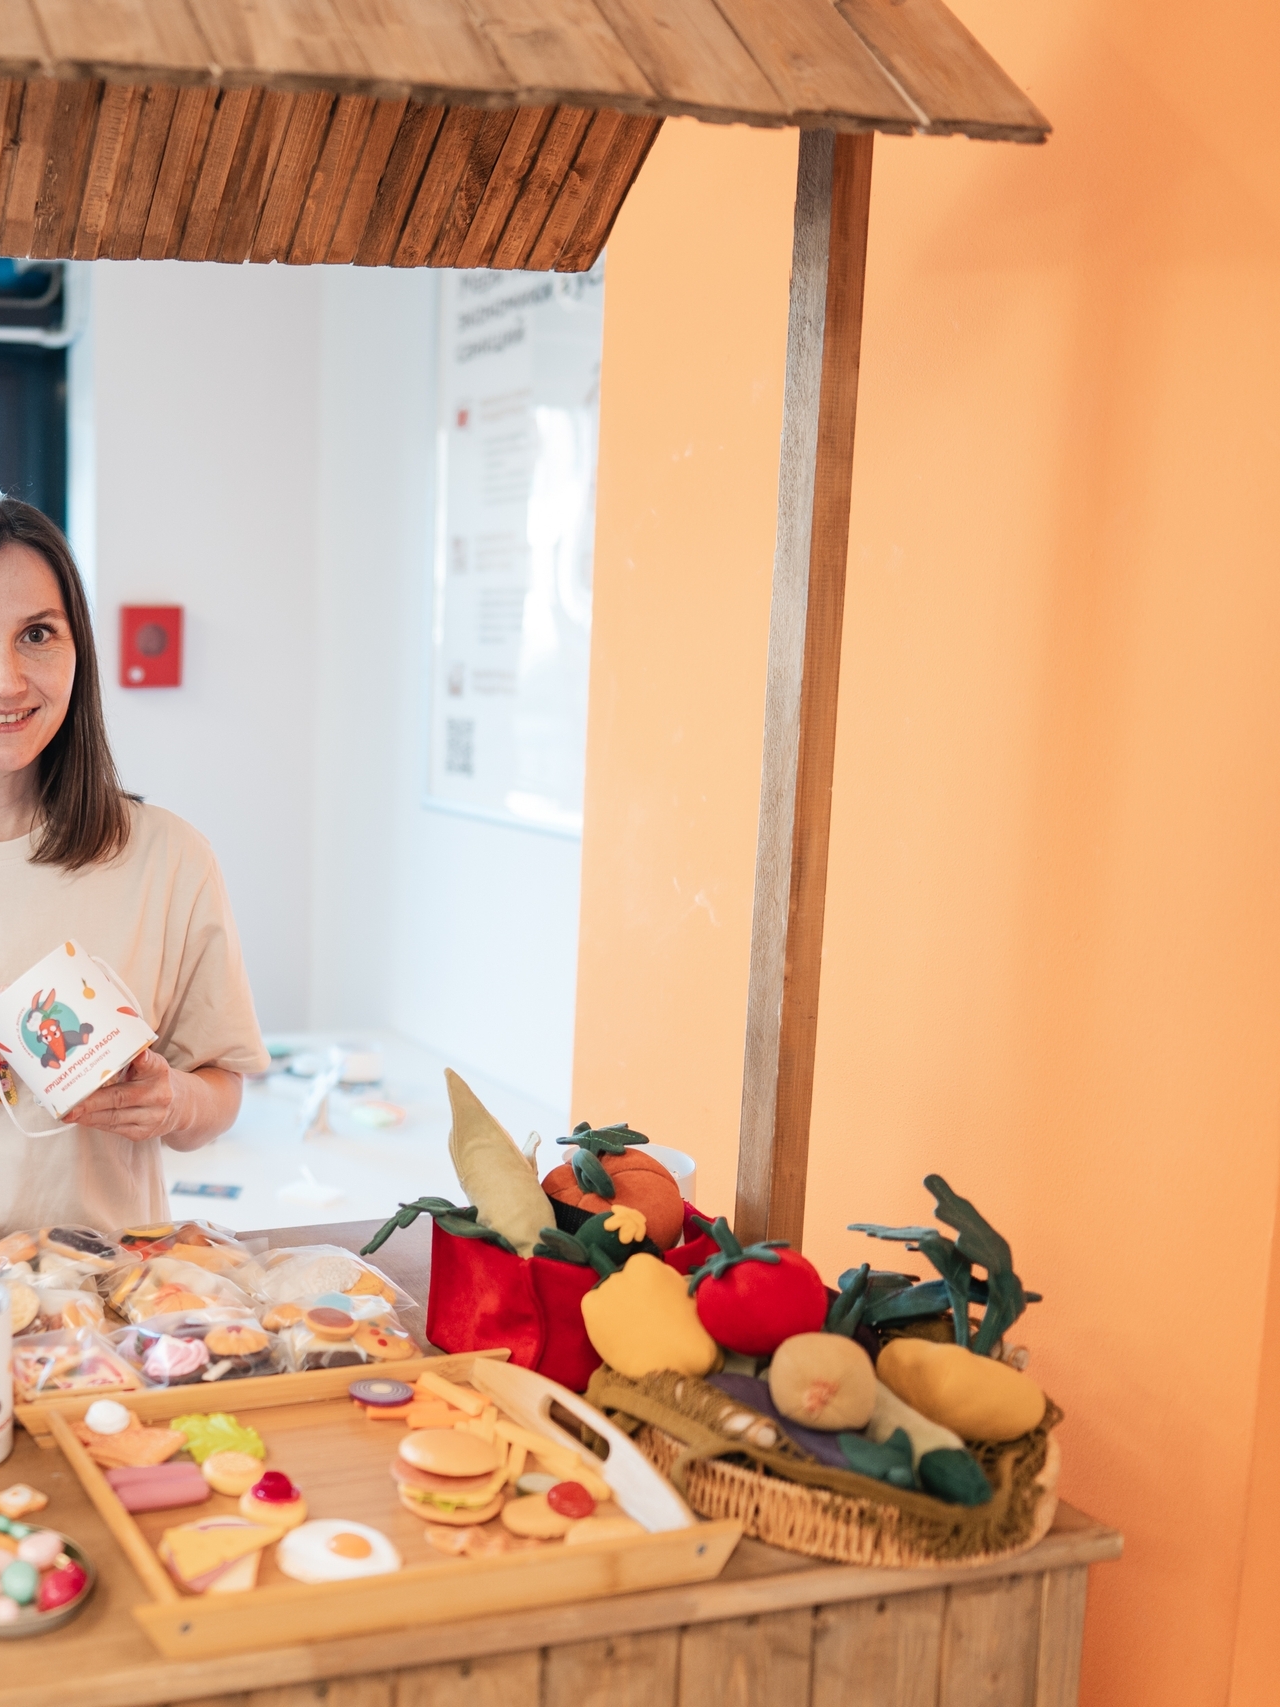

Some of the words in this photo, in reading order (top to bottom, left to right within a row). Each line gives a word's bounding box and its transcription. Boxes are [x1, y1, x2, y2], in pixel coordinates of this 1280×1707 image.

[44, 1071, 69, 1094] ИГРУШКИ
[67, 1048, 95, 1074] РУЧНОЙ
[94, 1027, 121, 1051] РАБОТЫ
